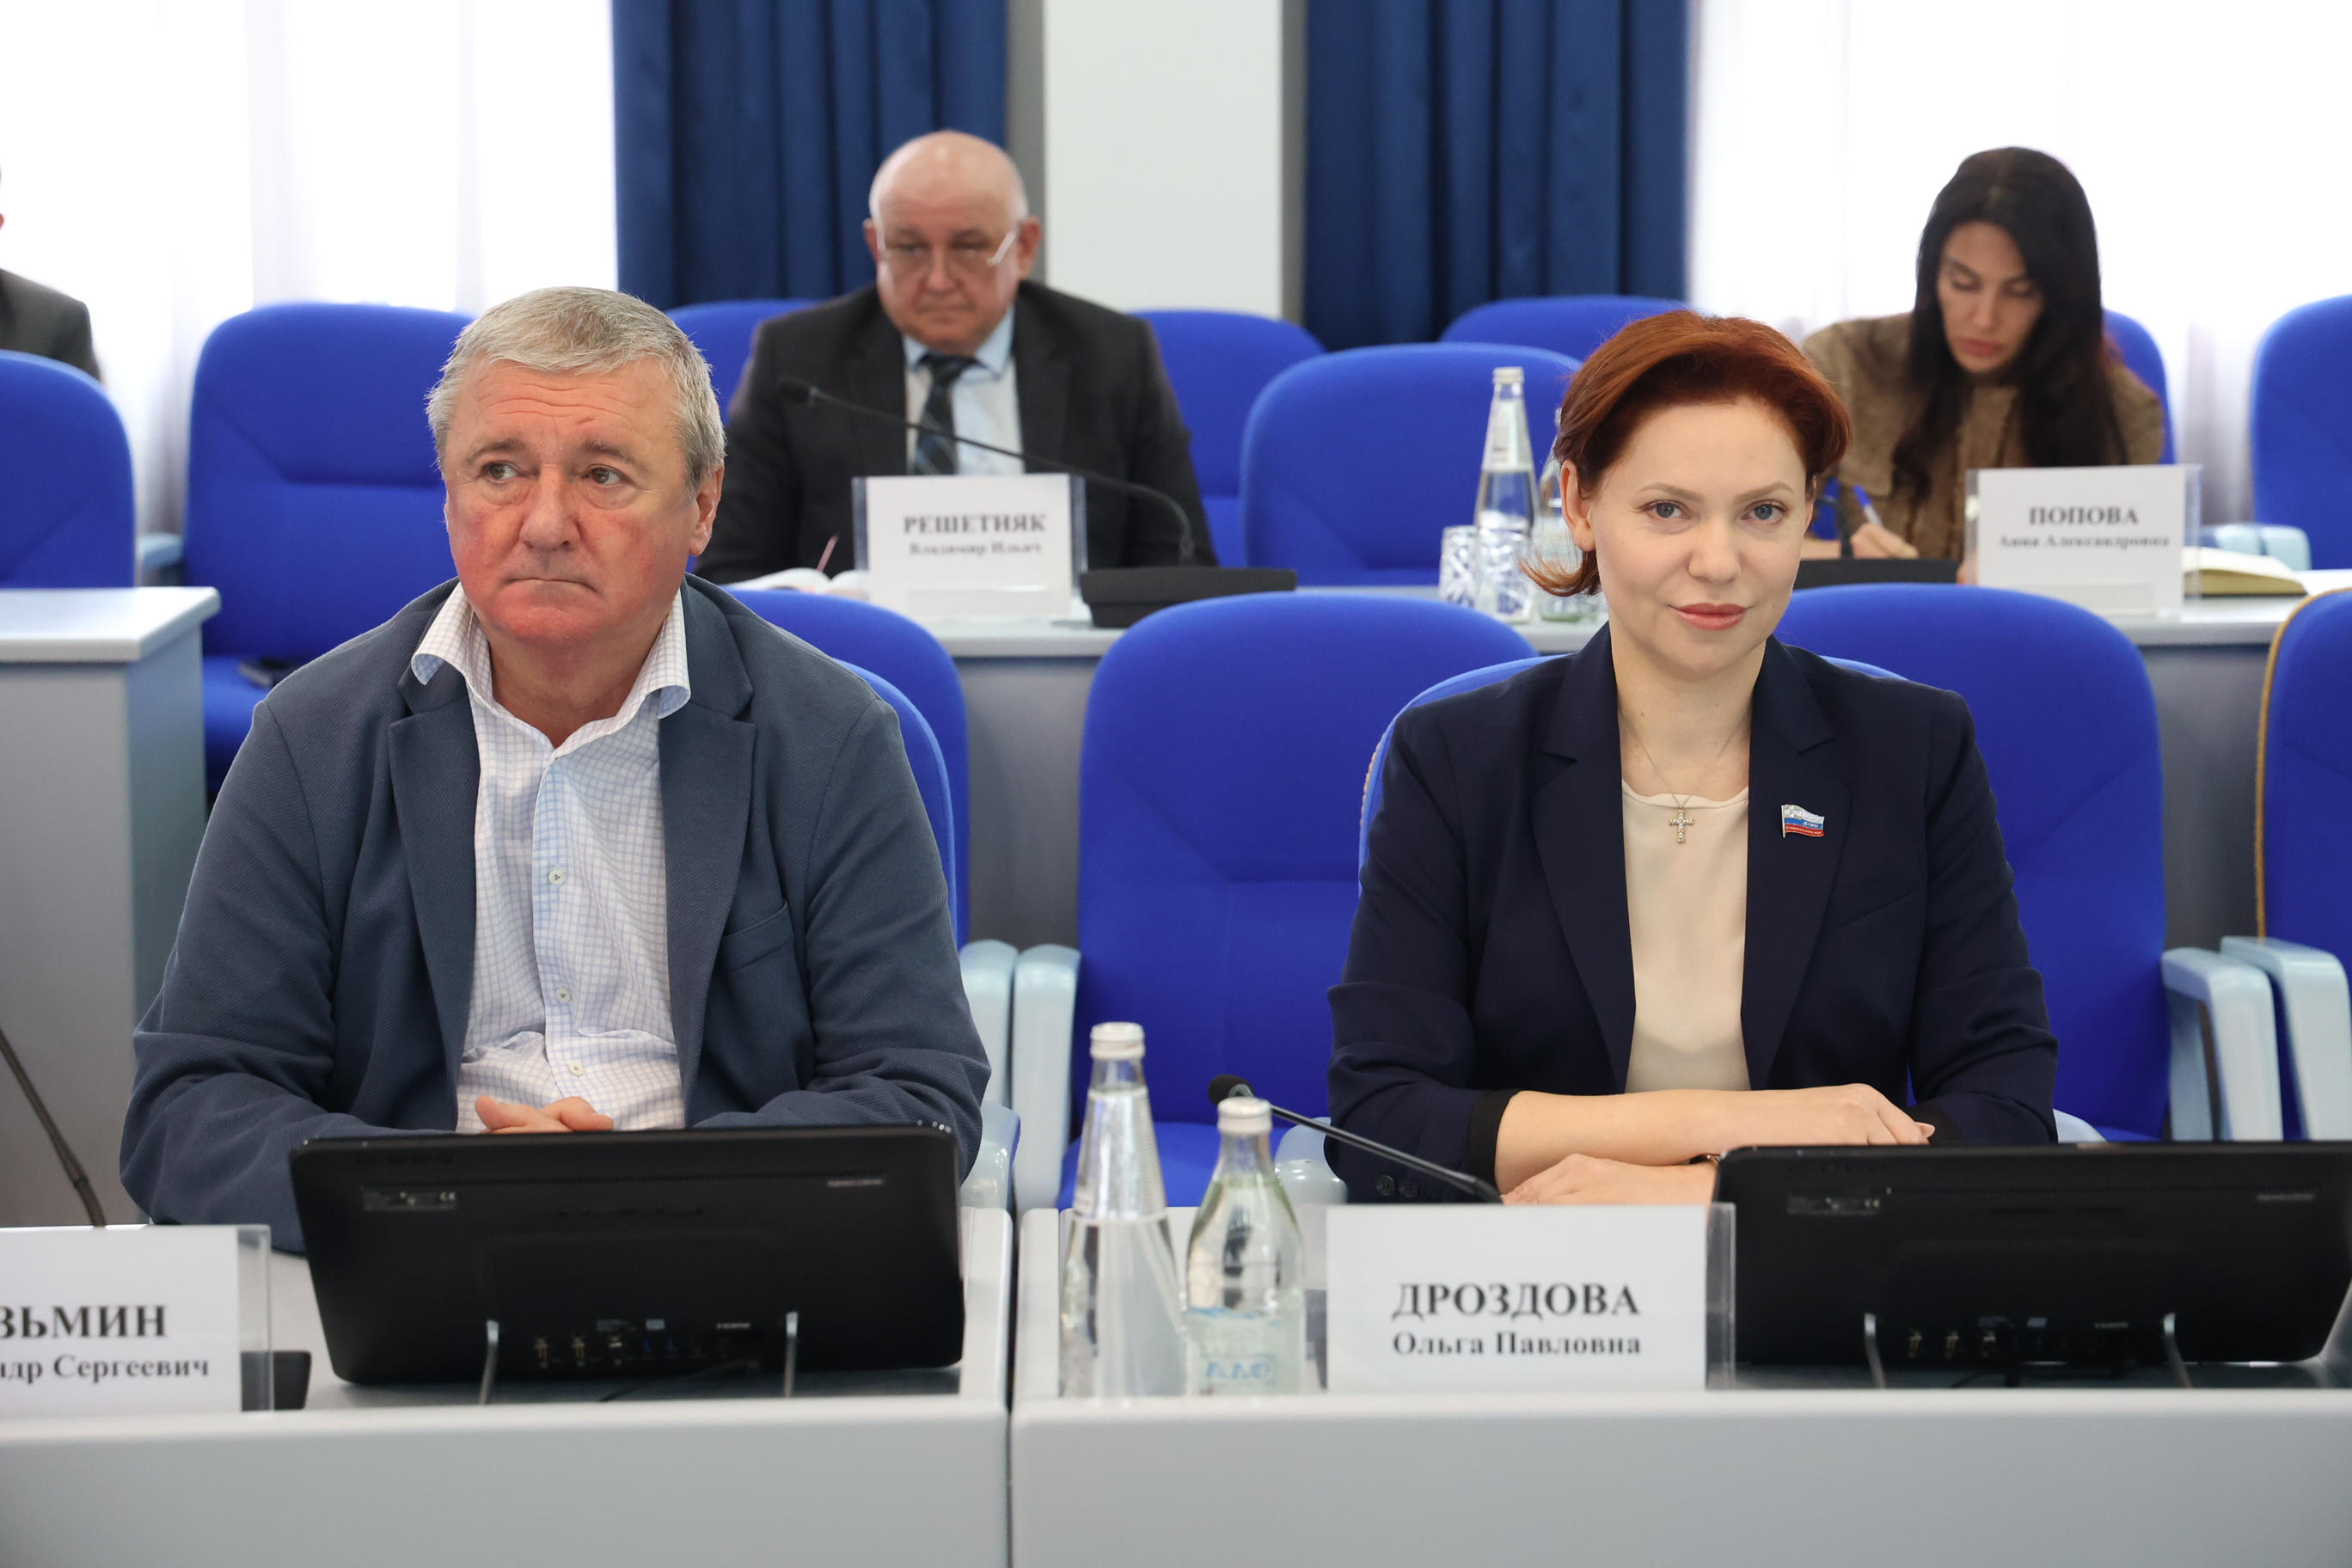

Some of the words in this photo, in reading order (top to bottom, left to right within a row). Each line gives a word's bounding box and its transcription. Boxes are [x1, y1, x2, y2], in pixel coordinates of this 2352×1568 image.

[903, 513, 1047, 535] РЕШЕТНЯК
[2028, 505, 2140, 526] ПОПОВА
[1390, 1282, 1641, 1321] ДРОЗДОВА
[0, 1303, 167, 1339] ЗЬМИН
[1392, 1331, 1485, 1357] Ольга
[1493, 1330, 1642, 1357] Павловна
[52, 1353, 210, 1386] Сергеевич
